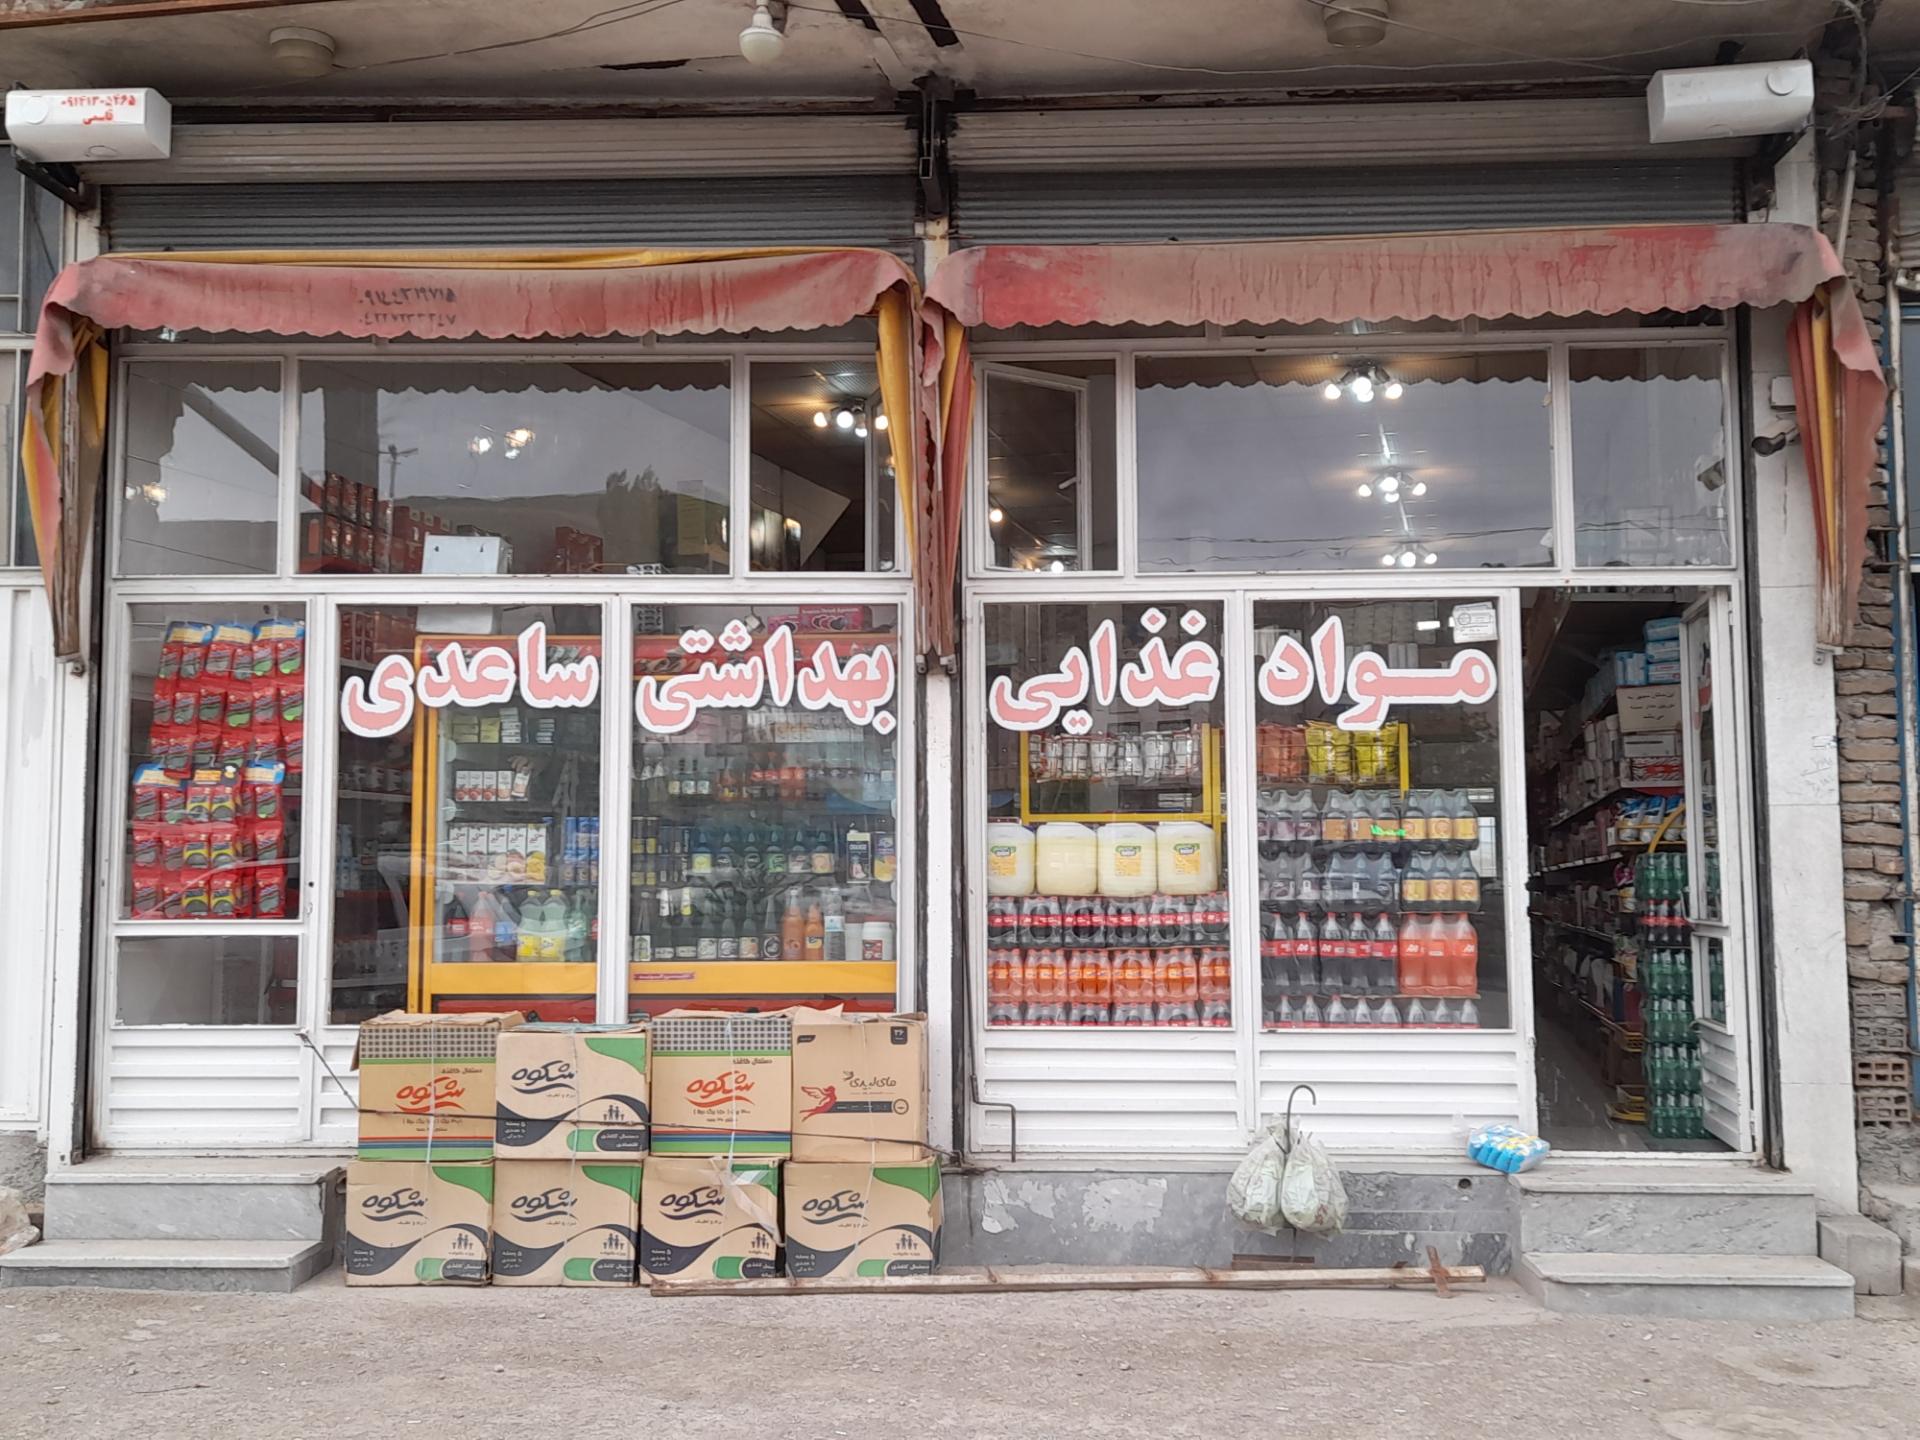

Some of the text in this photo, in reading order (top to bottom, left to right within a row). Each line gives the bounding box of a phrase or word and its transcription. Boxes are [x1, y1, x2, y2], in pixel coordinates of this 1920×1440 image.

[340, 621, 600, 738] ساعدی
[635, 619, 897, 735] بهداشتی
[989, 606, 1221, 736] غذایی
[510, 1059, 577, 1087] شکوه
[686, 1070, 756, 1100] شکوه
[396, 1075, 466, 1106] شکوه
[361, 1187, 428, 1214] شکوه
[510, 1187, 578, 1214] شکوه
[659, 1185, 726, 1213] شکوه
[801, 1189, 869, 1217] شکوه
